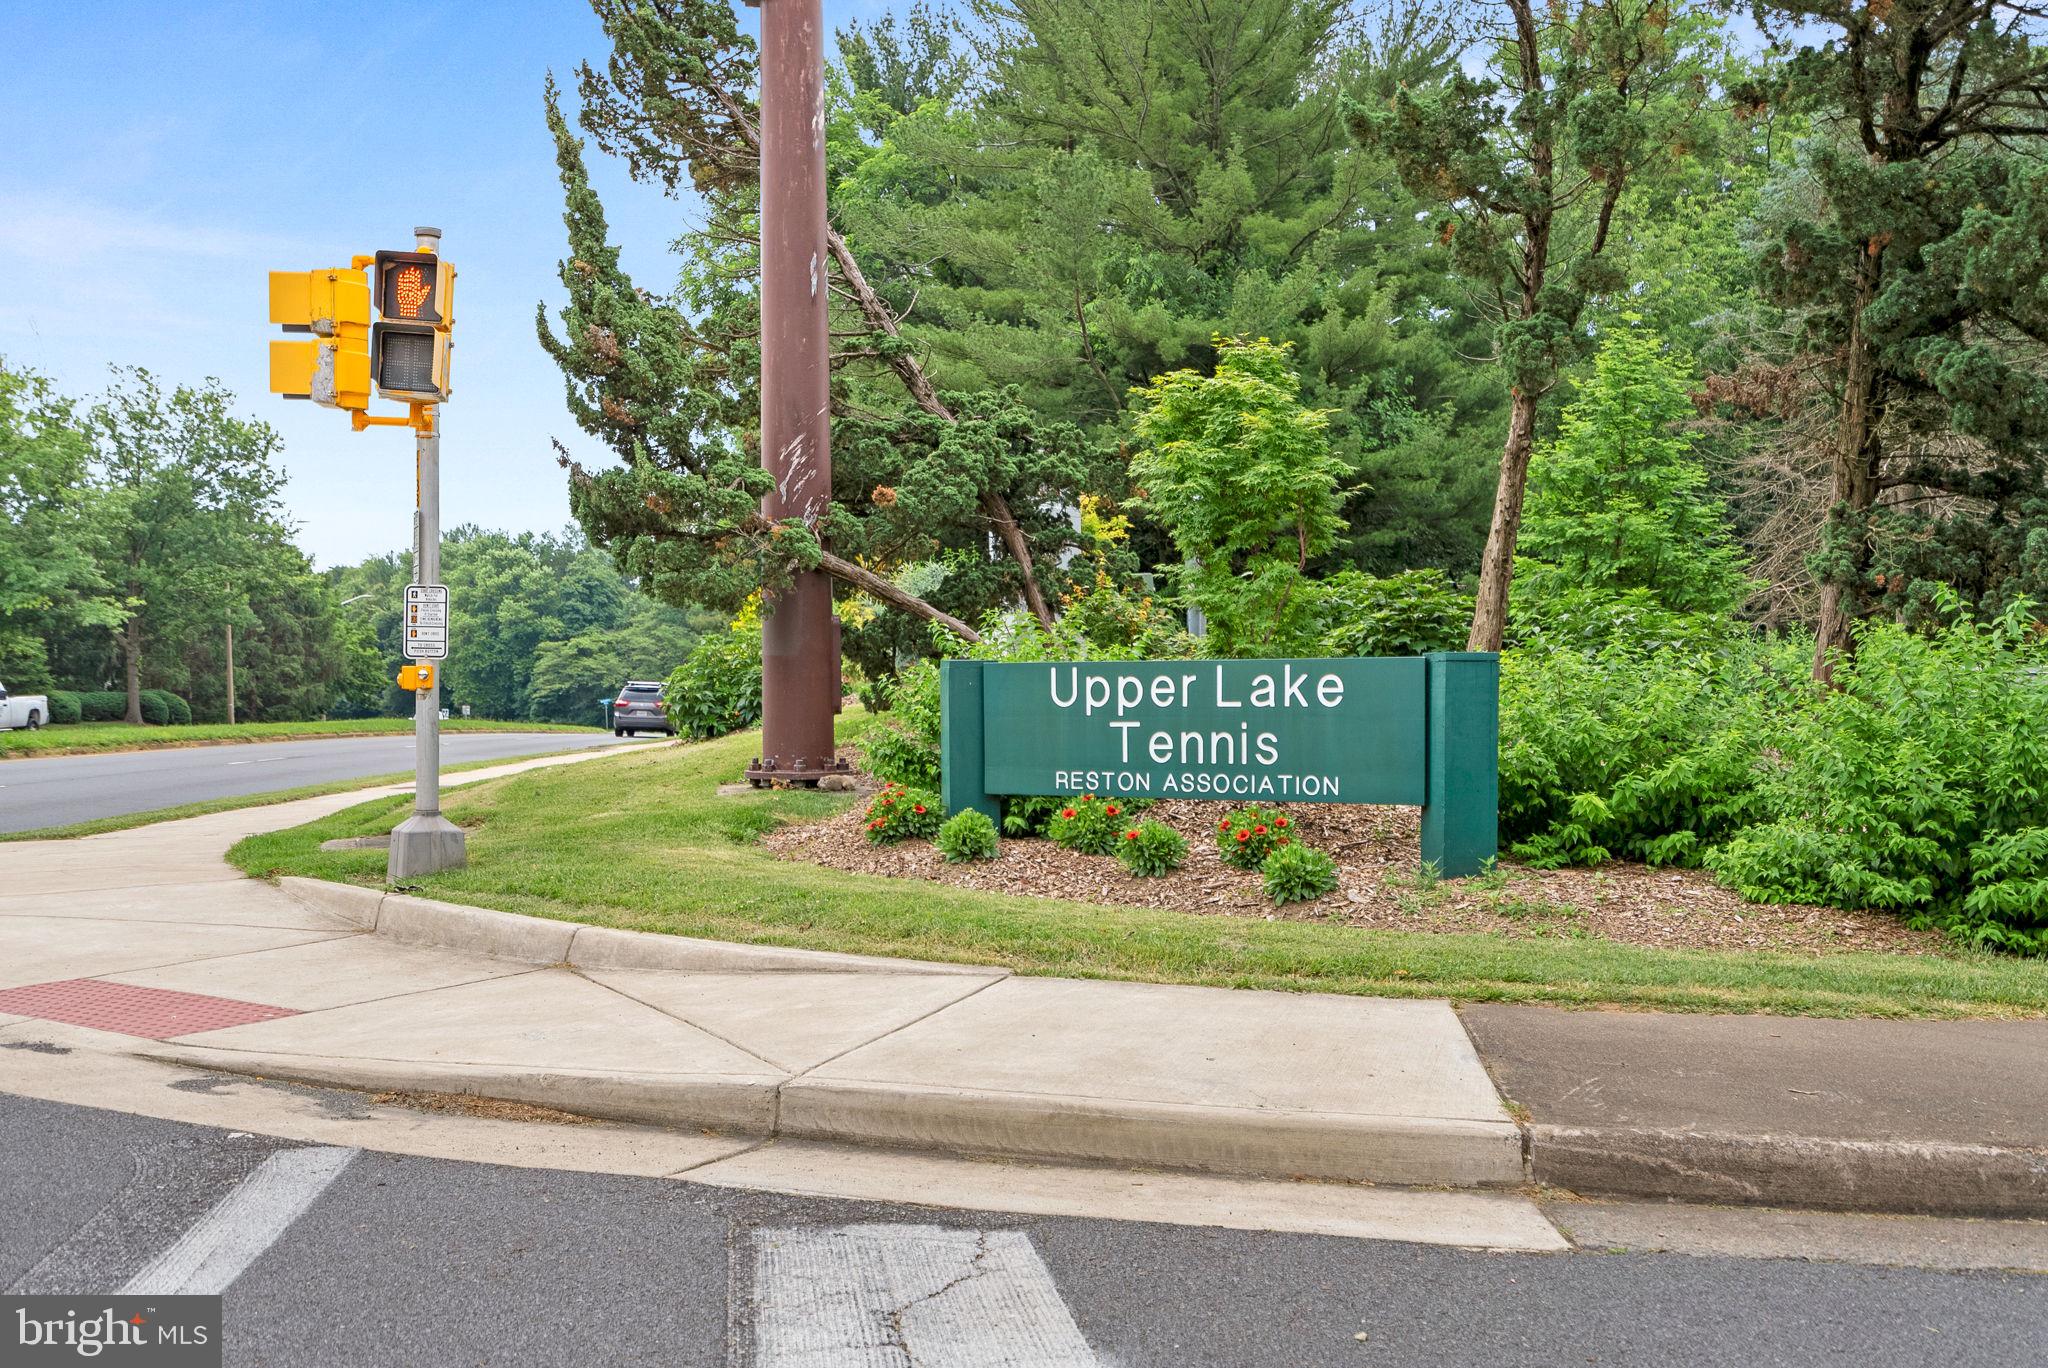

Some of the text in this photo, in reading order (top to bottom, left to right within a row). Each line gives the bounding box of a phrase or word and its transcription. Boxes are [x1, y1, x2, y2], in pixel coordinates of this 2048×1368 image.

[1049, 664, 1345, 716] Upper Lake
[1110, 722, 1278, 765] Tennis
[1056, 771, 1338, 795] RESTON ASSOCIATION
